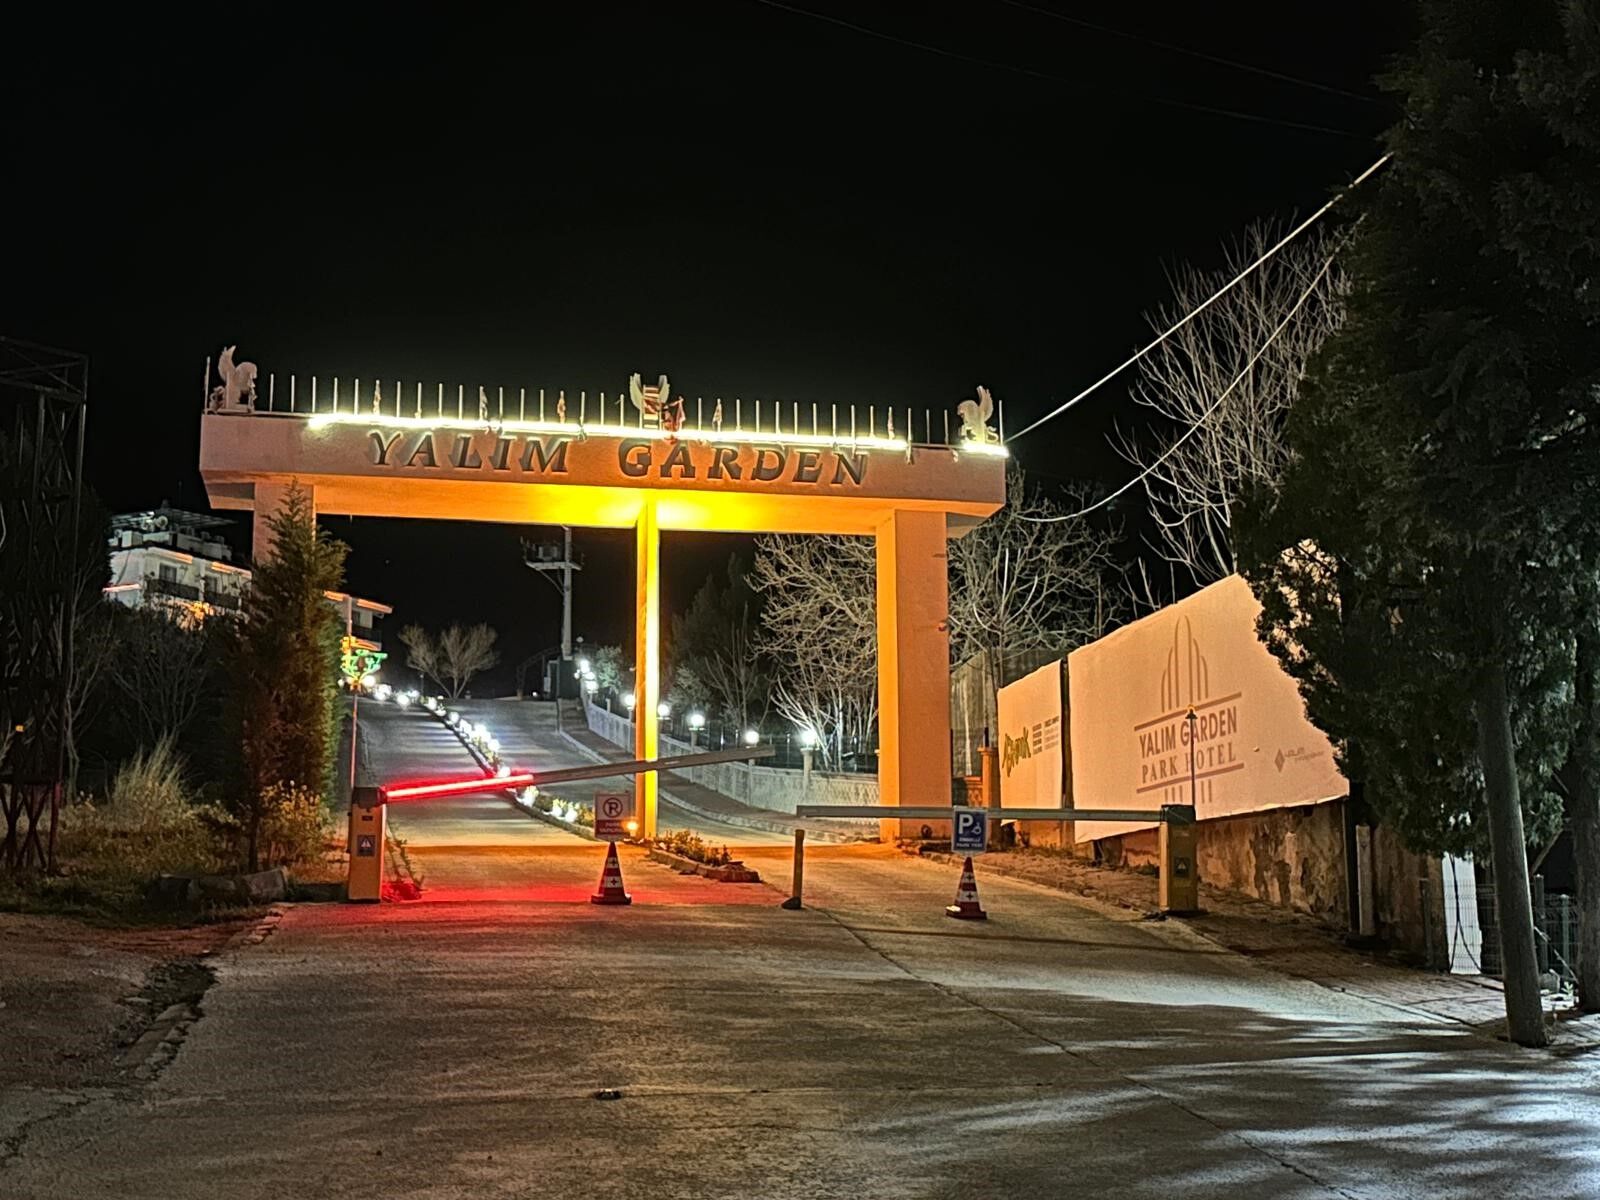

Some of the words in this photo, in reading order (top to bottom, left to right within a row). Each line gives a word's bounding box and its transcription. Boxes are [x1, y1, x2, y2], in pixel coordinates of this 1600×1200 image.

[367, 431, 572, 474] YALIM
[618, 438, 869, 486] GARDEN
[1139, 724, 1177, 759] YALIM
[1180, 706, 1237, 746] GARDEN
[1142, 755, 1179, 784] PARK
[958, 813, 974, 834] P
